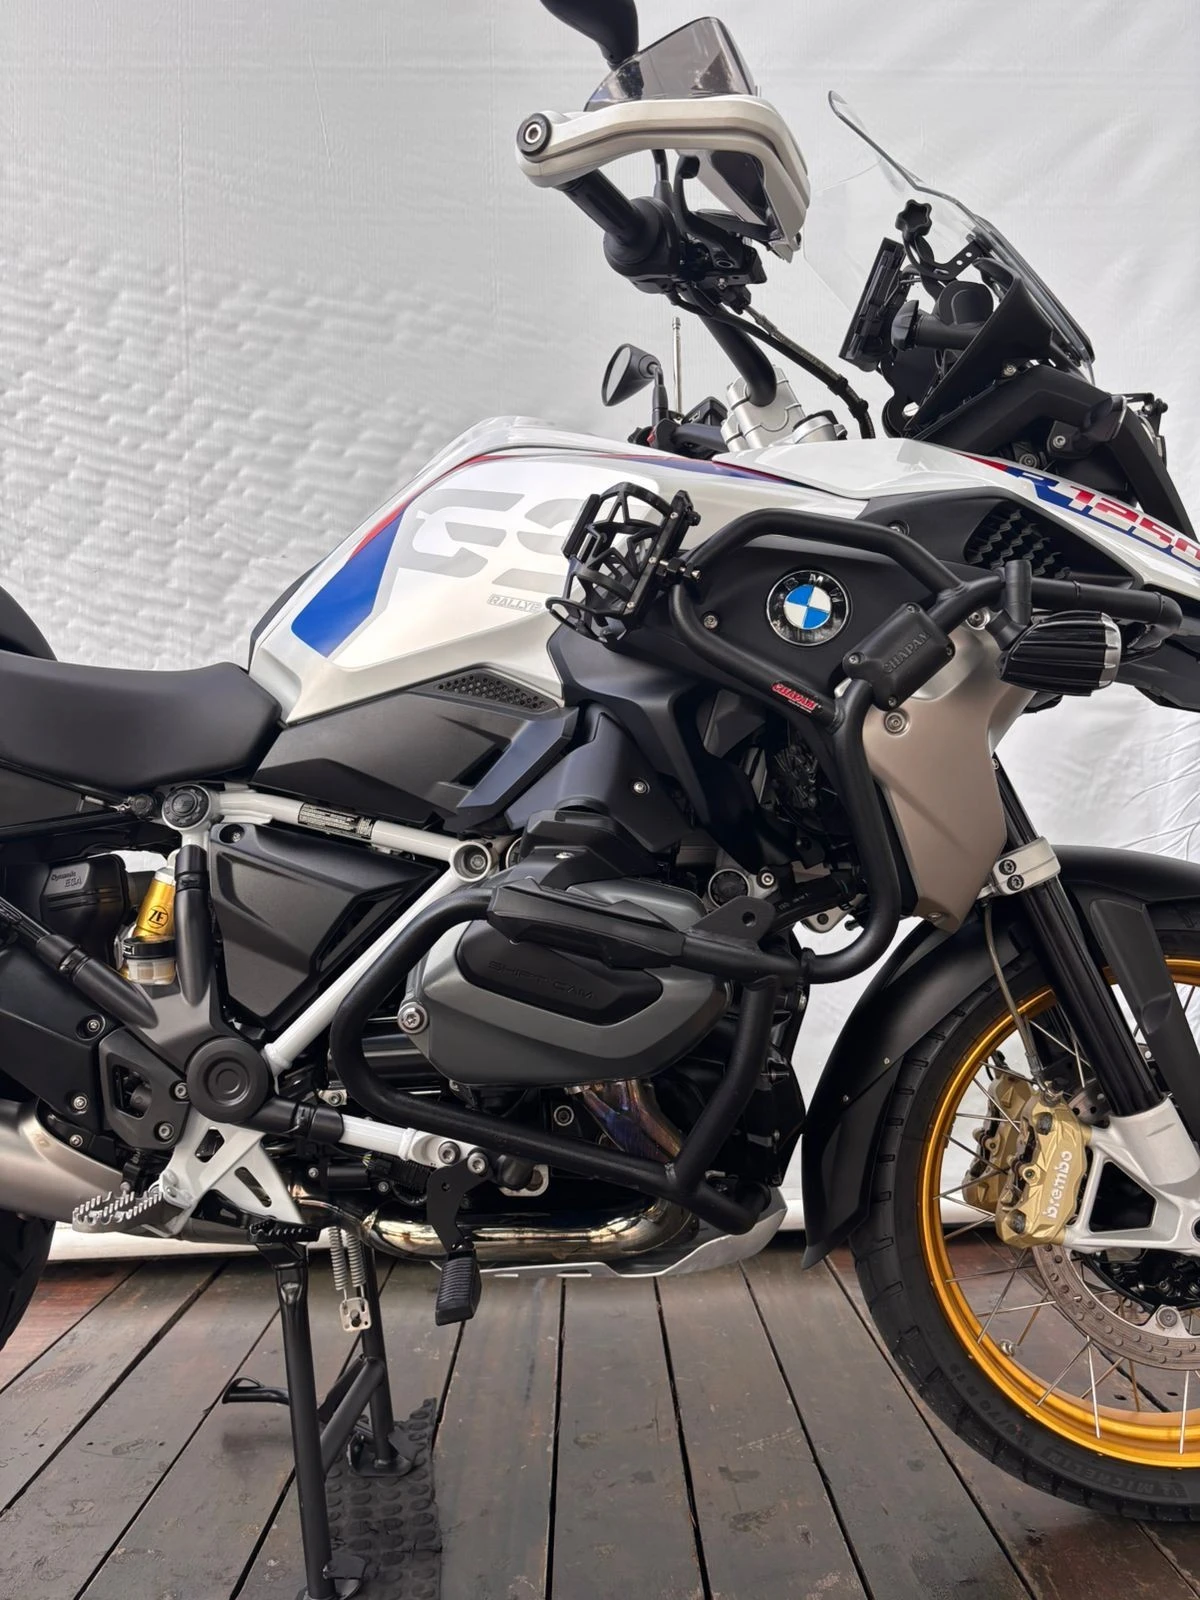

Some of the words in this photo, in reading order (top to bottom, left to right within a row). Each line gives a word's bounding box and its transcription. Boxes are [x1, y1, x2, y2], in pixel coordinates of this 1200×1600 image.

[1017, 468, 1073, 508] R
[782, 573, 844, 603] BMW
[148, 910, 168, 927] ZF
[1042, 1150, 1073, 1219] brembo
